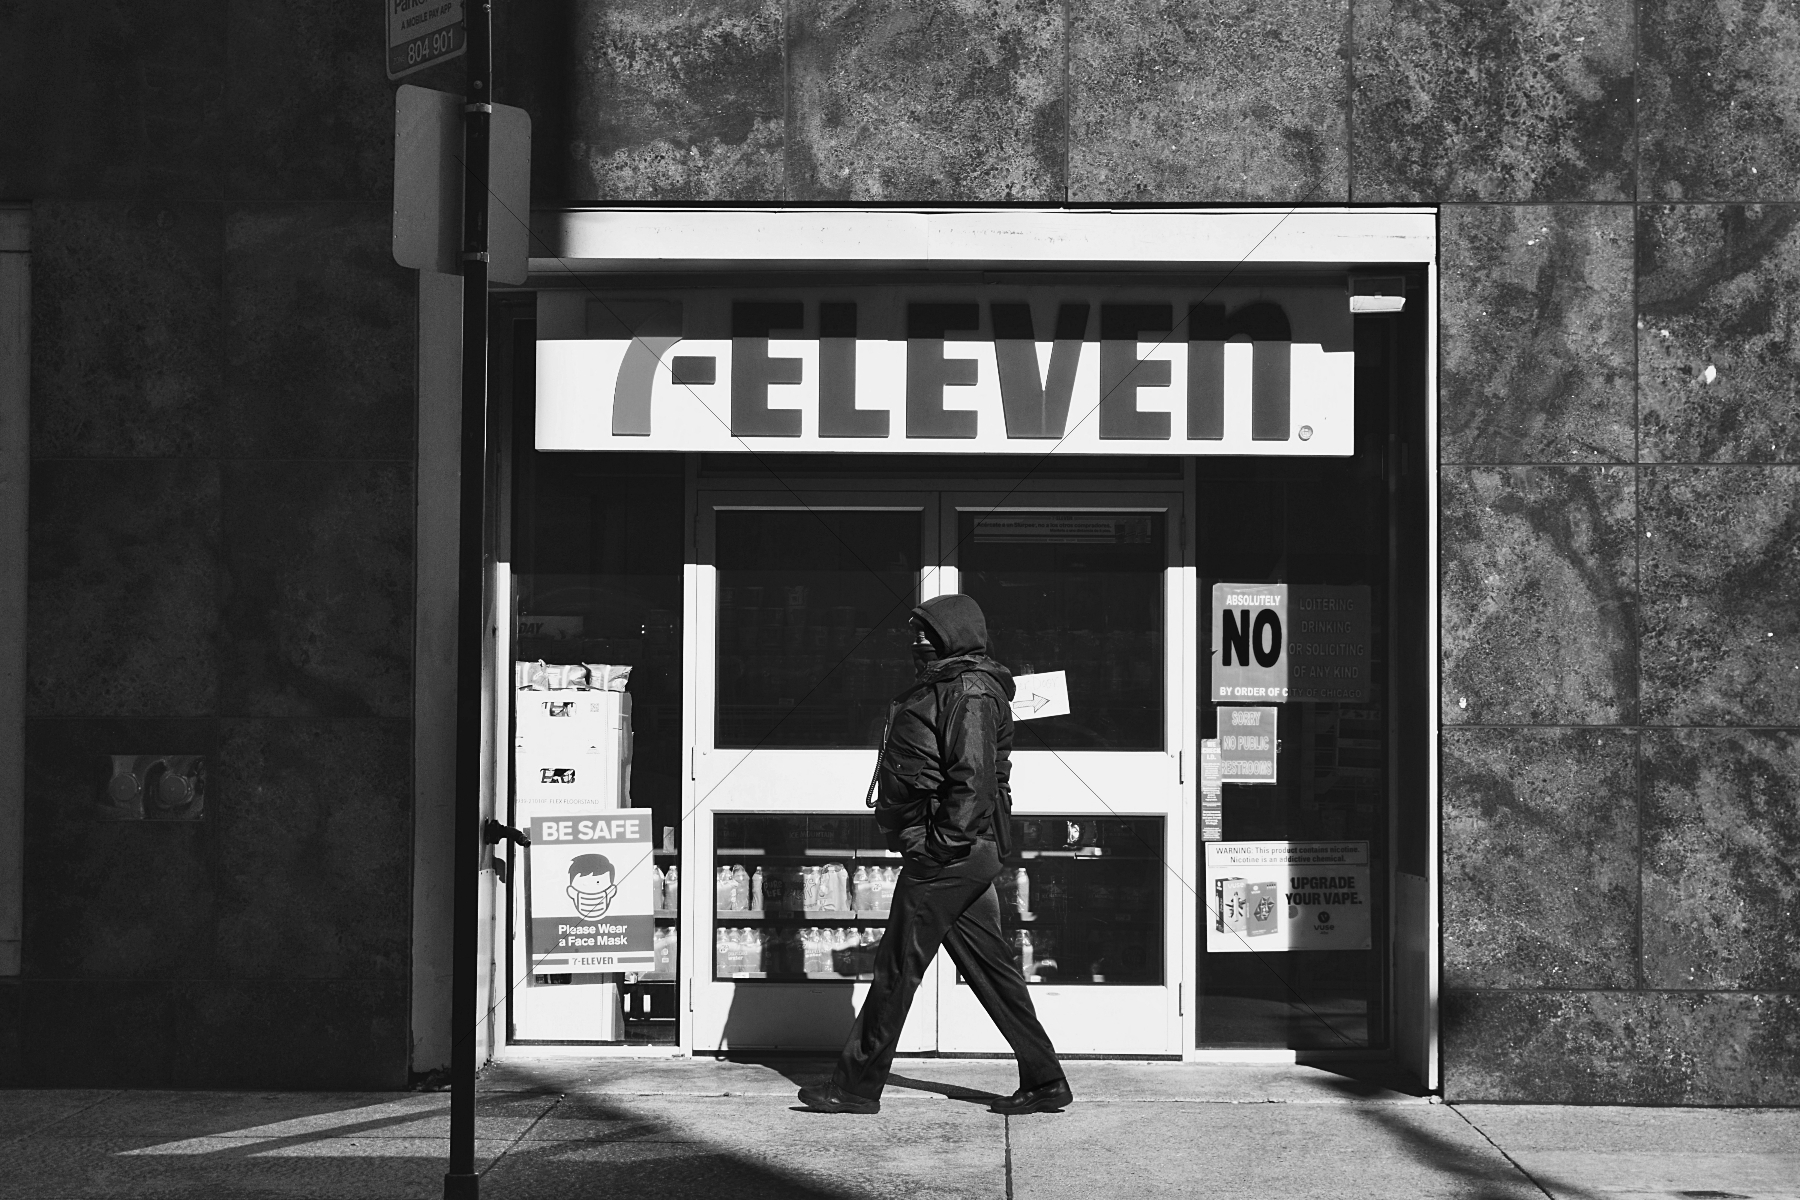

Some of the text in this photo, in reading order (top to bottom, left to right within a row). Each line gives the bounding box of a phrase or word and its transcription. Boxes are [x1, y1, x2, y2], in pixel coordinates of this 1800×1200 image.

[401, 2, 452, 31] A MOBILE PAY APP
[407, 37, 430, 65] 804
[433, 28, 454, 55] 901
[1226, 595, 1281, 606] ABSOLUTELY
[1299, 598, 1354, 611] LOITERING
[1301, 621, 1352, 634] DRINKING
[1222, 608, 1282, 668] NO
[1289, 643, 1364, 656] OR SOLICITING
[1293, 665, 1359, 679] OF ANY KIND
[1220, 686, 1362, 698] BY ORDER OF CITY OF CHICAGO
[1231, 711, 1262, 726] SORRY
[1223, 735, 1269, 751] NO PUBLIC
[1221, 760, 1273, 776] RESTROOMS
[542, 819, 640, 841] BE SAFE
[1215, 846, 1360, 855] WARNING: This product contains nicotine.
[1279, 855, 1311, 863] addictive
[1312, 855, 1346, 863] chemical.
[1291, 876, 1355, 889] UPGRADE
[1285, 892, 1363, 905] YOUR VAPE.
[558, 923, 628, 936] Please Wear
[559, 935, 628, 947] a Face Mask
